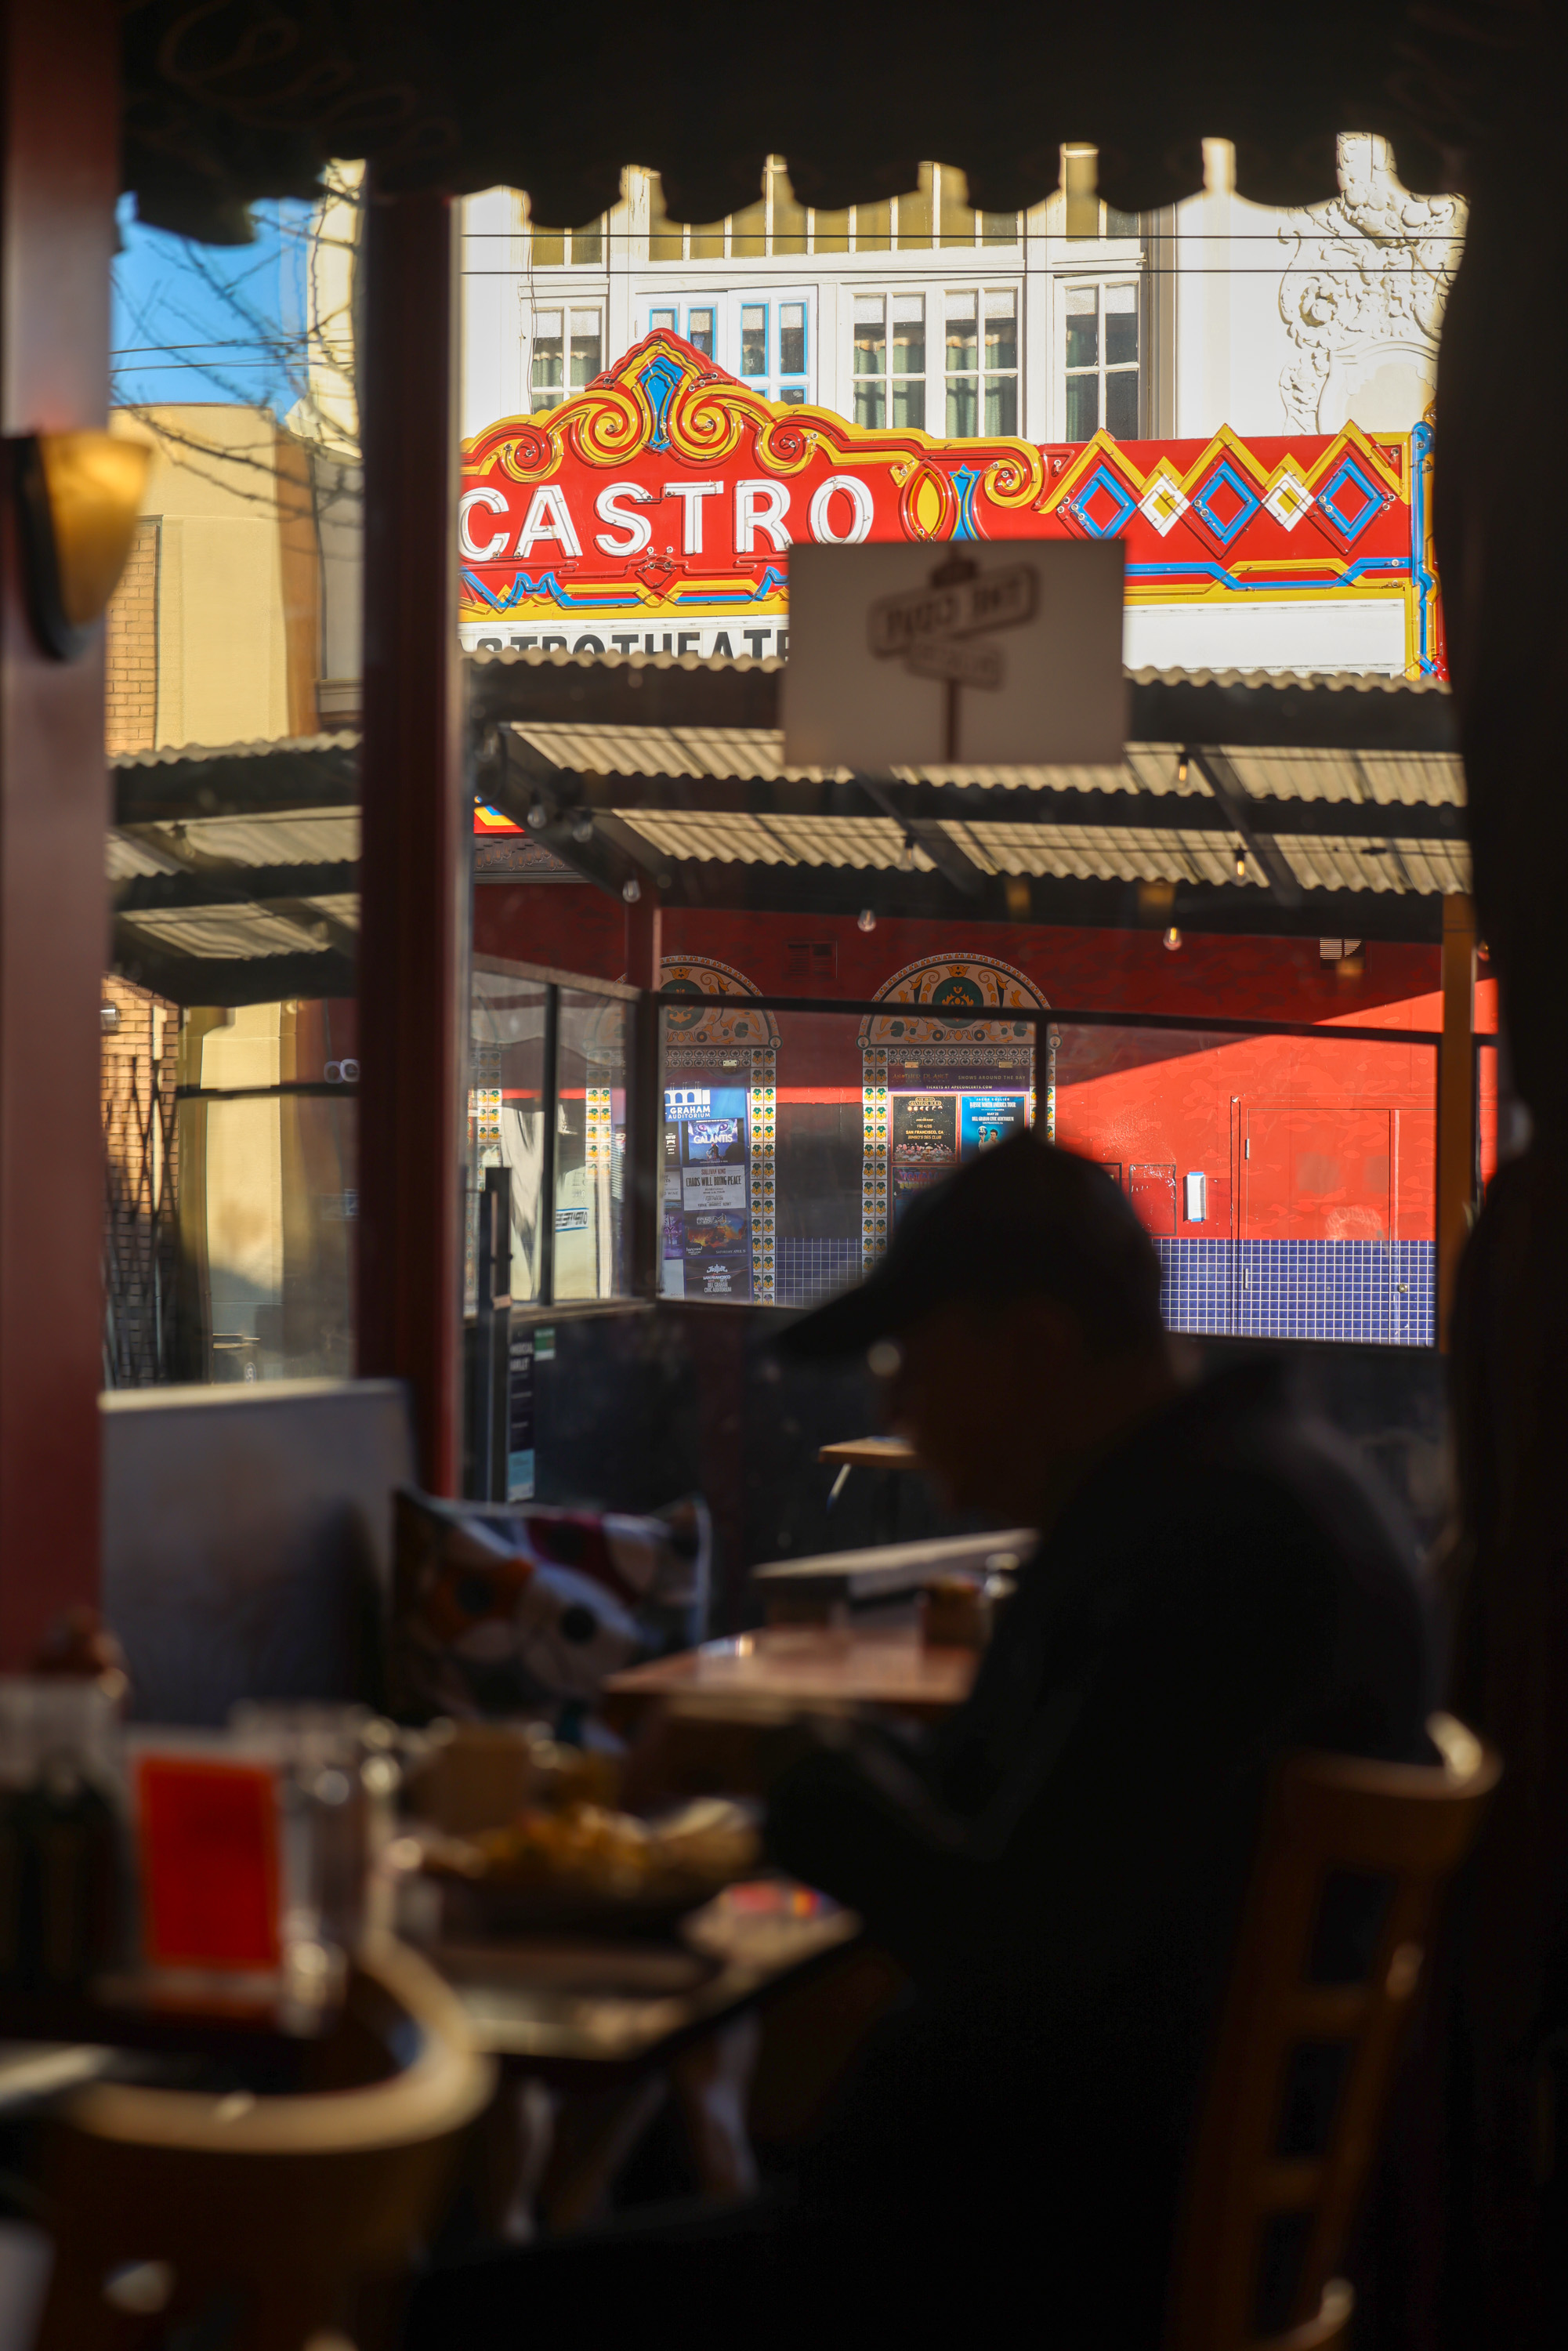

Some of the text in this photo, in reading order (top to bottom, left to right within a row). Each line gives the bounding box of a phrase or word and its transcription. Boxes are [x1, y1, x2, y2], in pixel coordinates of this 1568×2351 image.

[458, 475, 875, 560] CASTRO
[670, 1106, 711, 1114] GRAHAM
[693, 1135, 733, 1143] GALANTIS
[686, 1177, 701, 1186] CHAOS
[701, 1176, 712, 1186] WILL
[727, 1176, 741, 1185] PEACE
